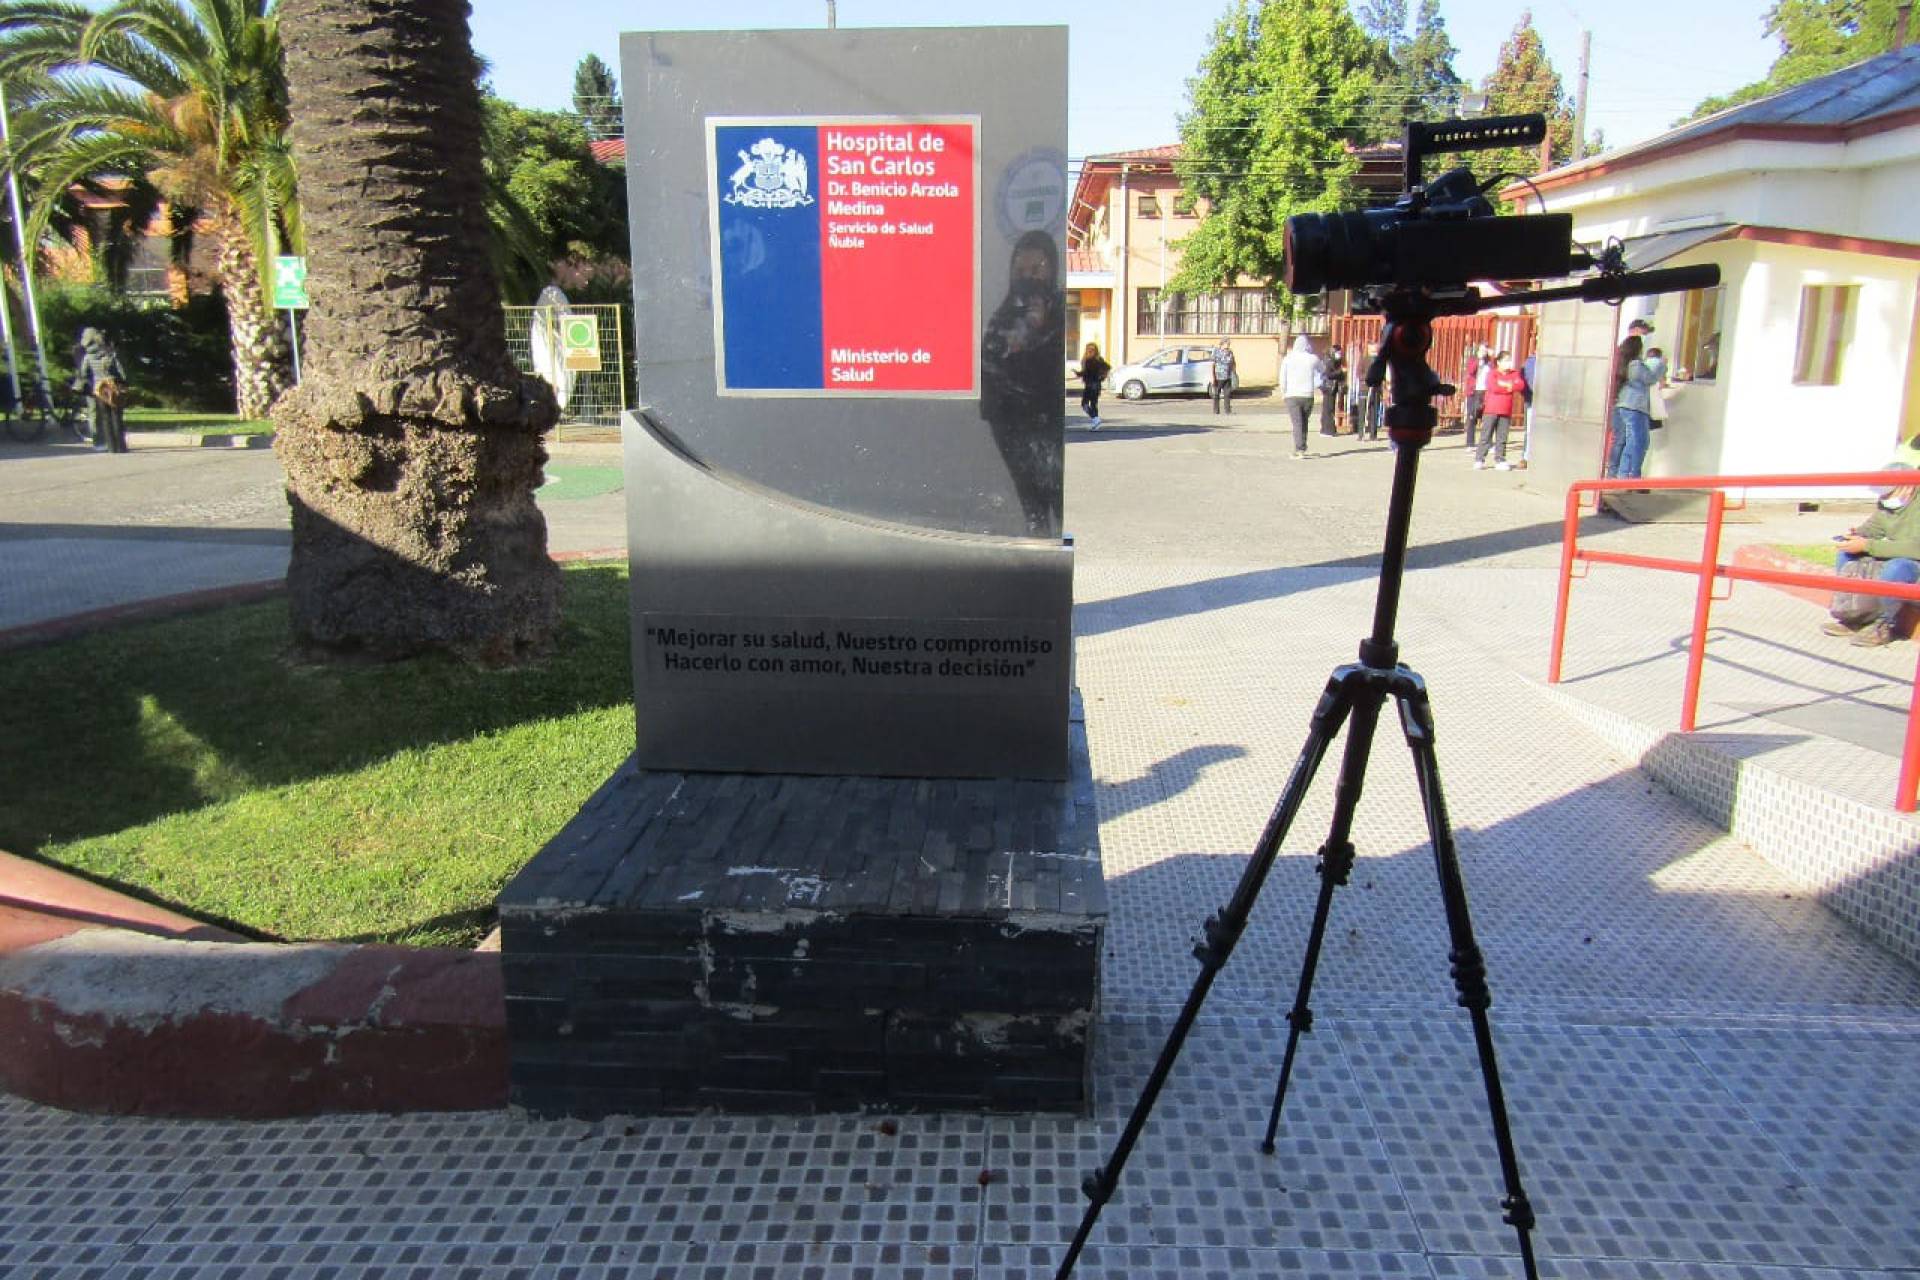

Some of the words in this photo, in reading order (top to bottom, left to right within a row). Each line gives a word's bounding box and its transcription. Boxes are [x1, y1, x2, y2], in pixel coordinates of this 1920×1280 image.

[827, 132, 913, 154] Hospital
[918, 133, 944, 152] de
[827, 156, 865, 175] San
[871, 156, 935, 176] Carlos
[827, 181, 849, 197] Dr.
[851, 182, 908, 198] Benicio
[911, 182, 960, 198] Arzola
[828, 201, 884, 216] Medina
[828, 222, 878, 235] Servicio
[881, 223, 895, 235] de
[899, 222, 934, 235] Salud
[828, 235, 865, 249] Ñuble
[831, 349, 909, 364] Ministerio
[912, 350, 931, 364] de
[831, 367, 874, 382] Salud
[742, 634, 765, 648] su
[770, 631, 831, 651] salud,
[836, 632, 918, 651] Nuestro
[923, 634, 1053, 657] compromiso
[664, 653, 742, 672] Hacerlo
[747, 657, 784, 672] con
[789, 658, 846, 676] amor,
[852, 657, 933, 676] Nuestra
